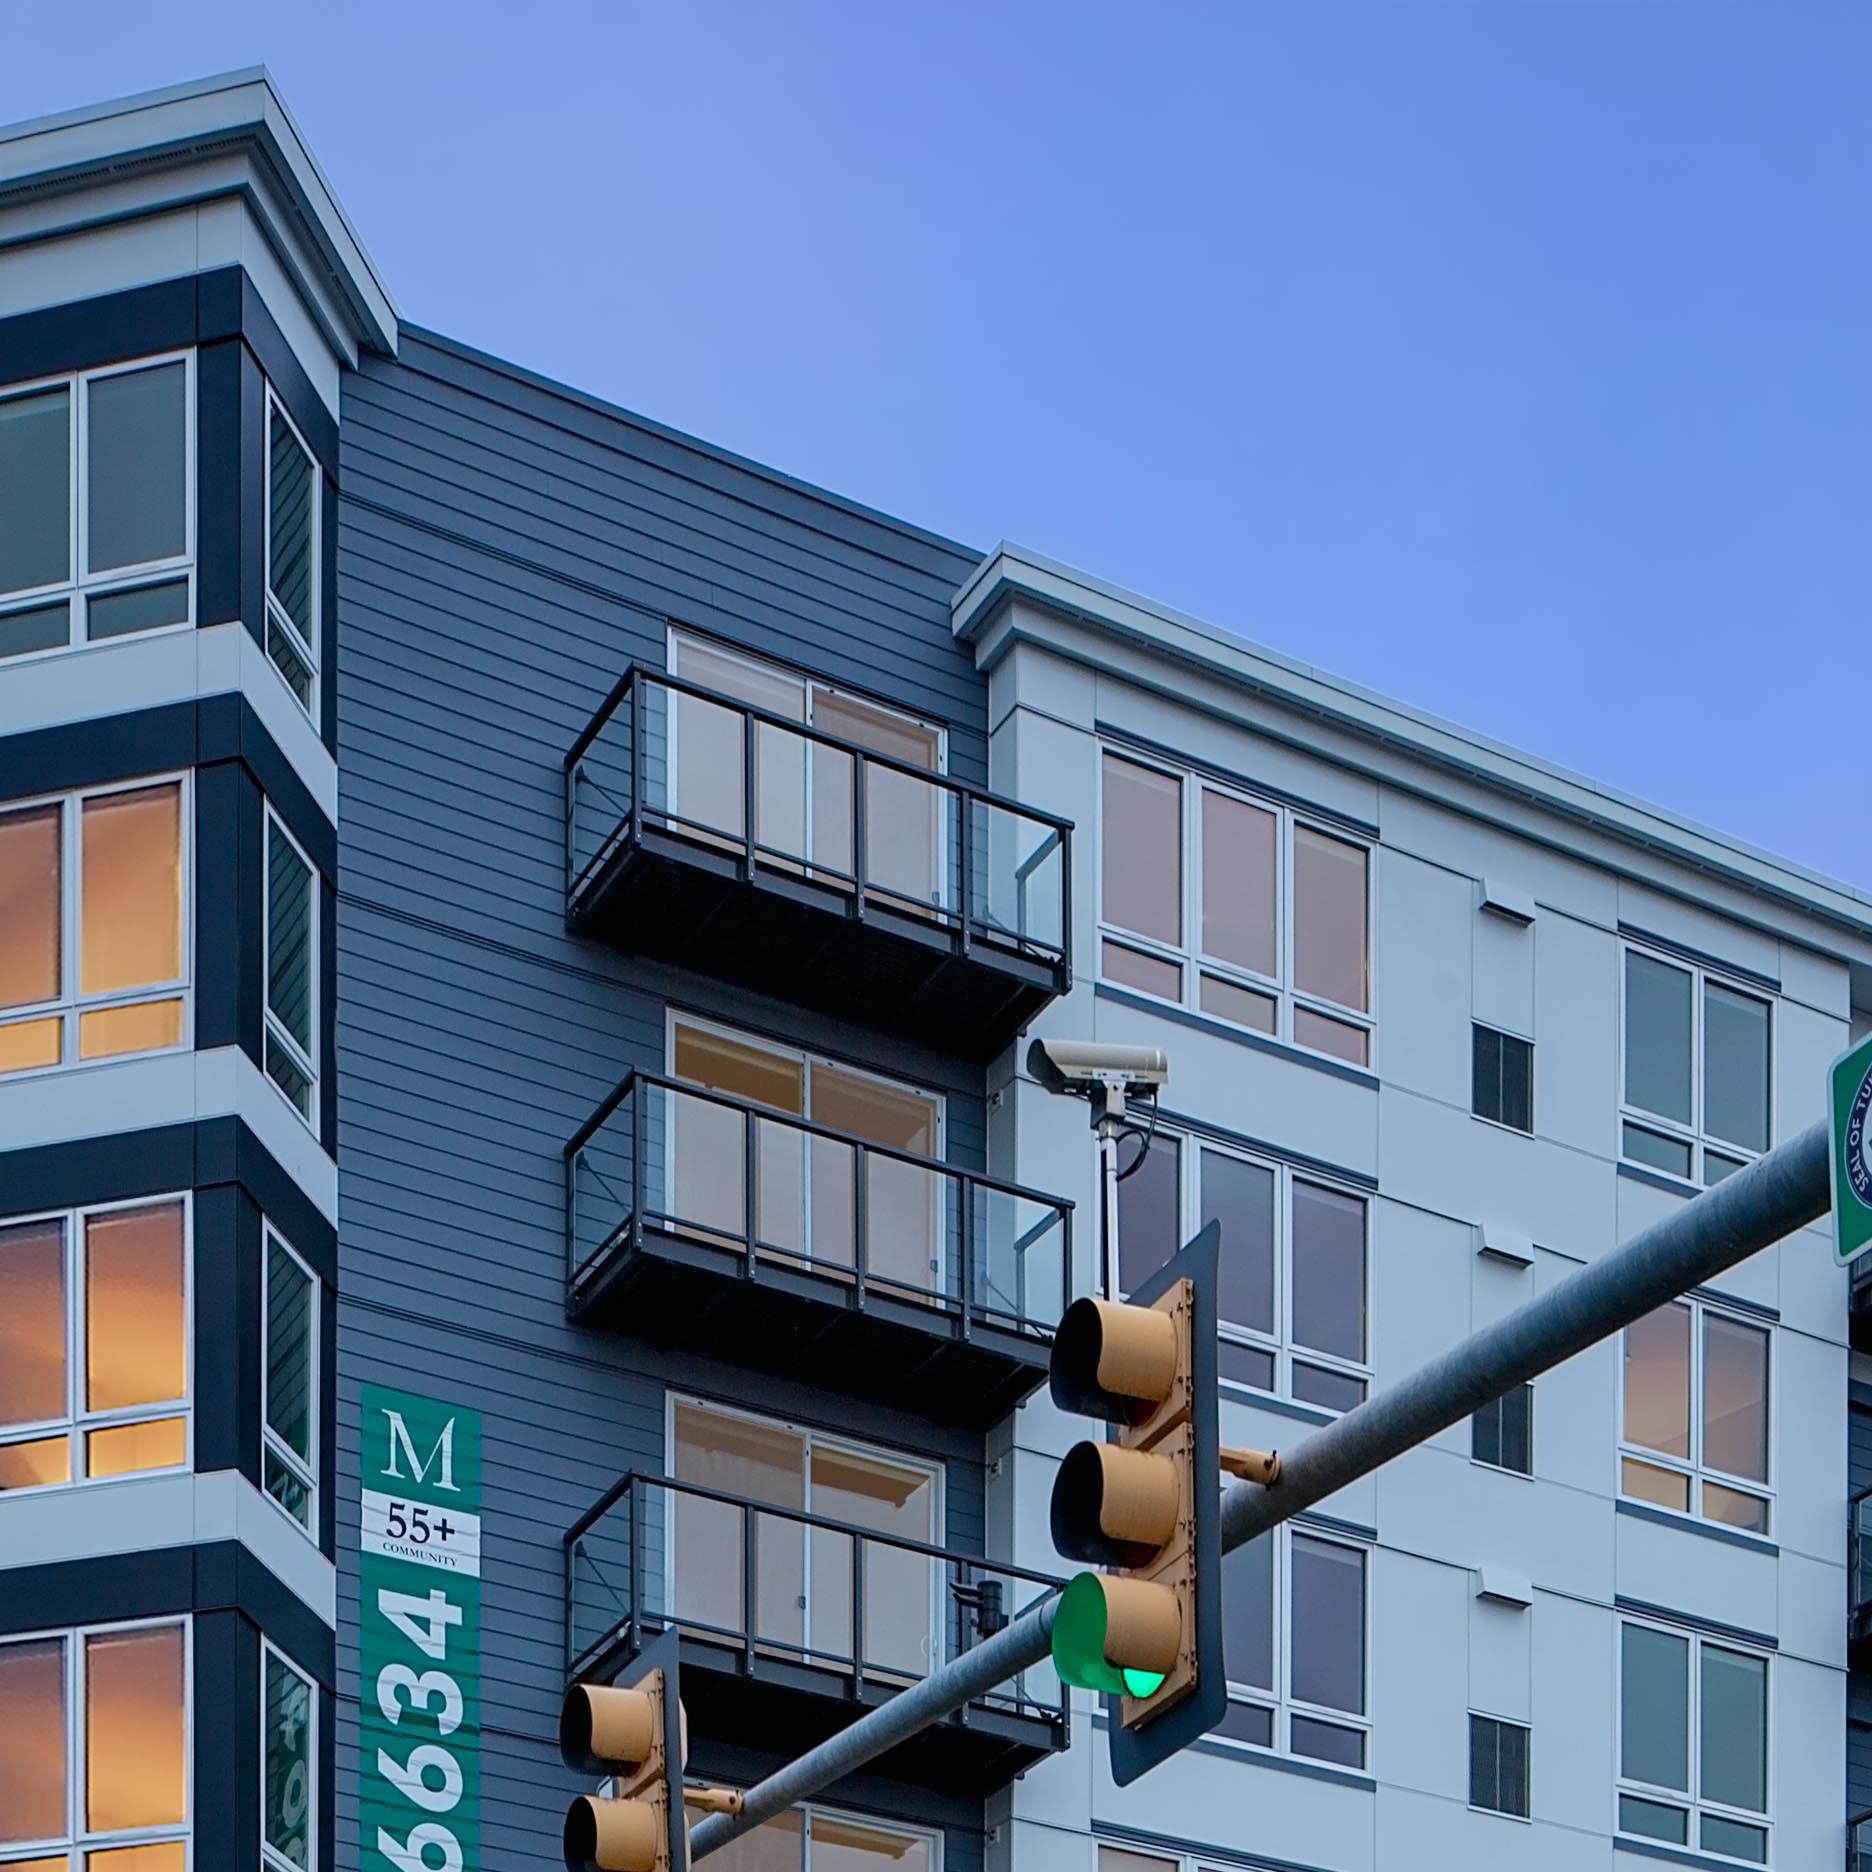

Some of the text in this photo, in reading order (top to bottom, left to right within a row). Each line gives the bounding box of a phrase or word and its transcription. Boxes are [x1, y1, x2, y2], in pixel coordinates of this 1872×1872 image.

[1849, 1118, 1863, 1145] OF
[1848, 1150, 1869, 1193] SEAL
[381, 1408, 462, 1492] M
[386, 1502, 455, 1543] 55+
[382, 1542, 457, 1566] COMMUNITY
